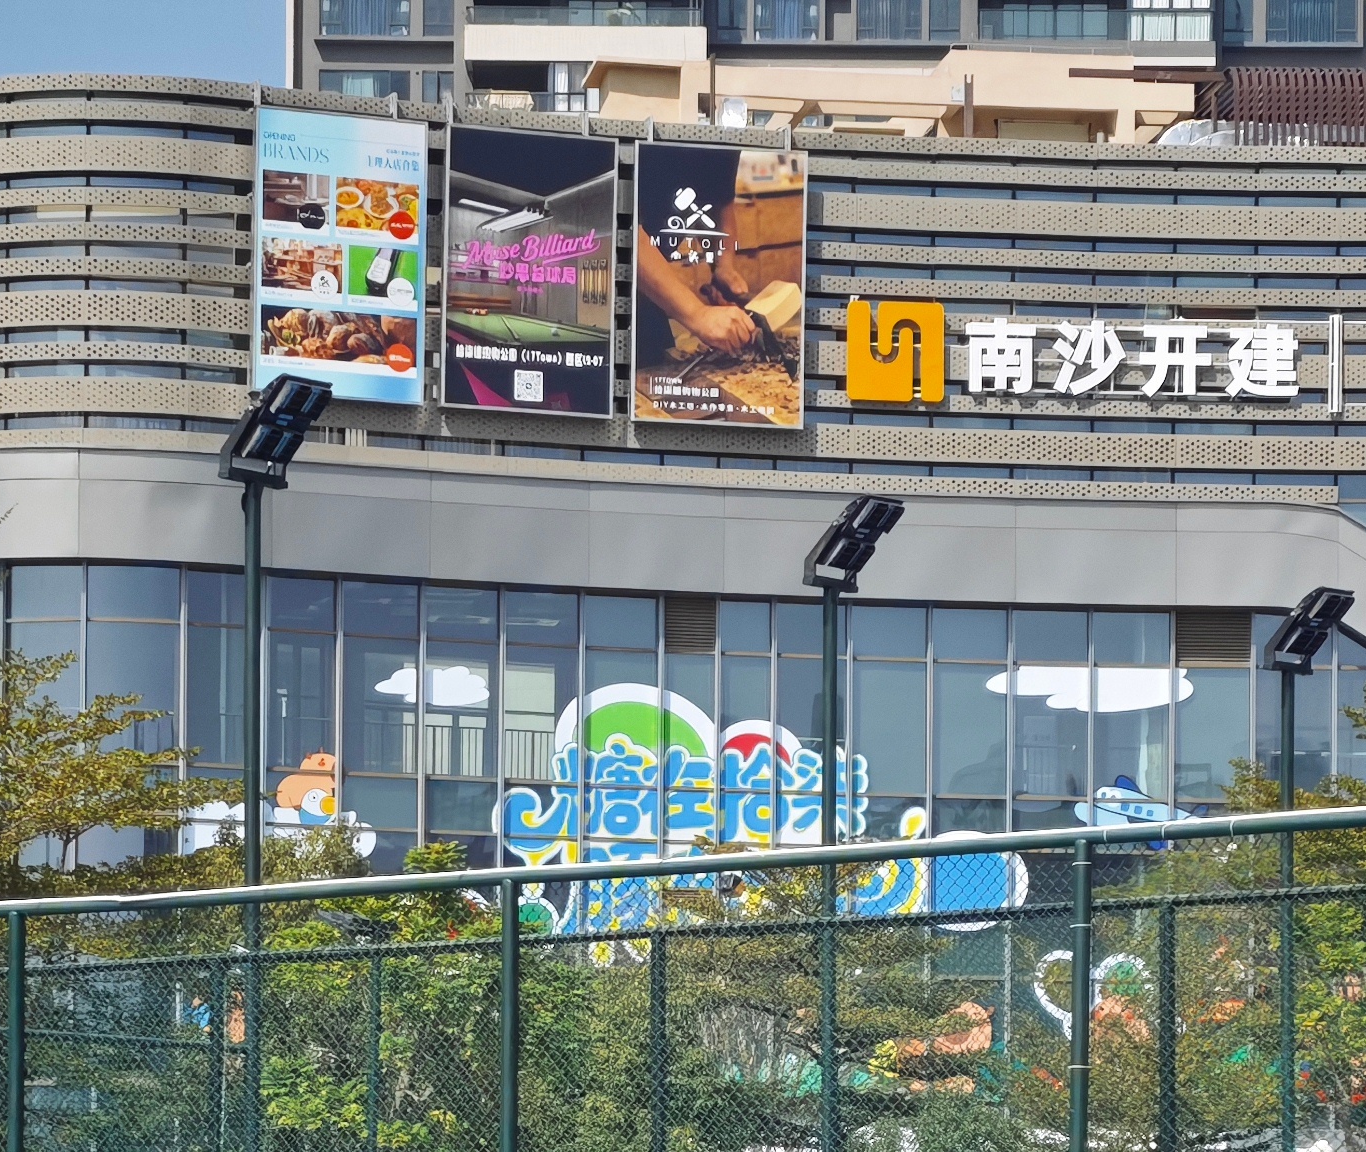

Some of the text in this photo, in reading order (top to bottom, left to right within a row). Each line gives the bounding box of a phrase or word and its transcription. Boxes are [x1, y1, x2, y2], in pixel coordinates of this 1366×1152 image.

[263, 143, 330, 163] BRANDS
[520, 228, 601, 264] Billiard
[649, 235, 739, 251] MUTOLI
[964, 317, 1301, 398] 南沙开建
